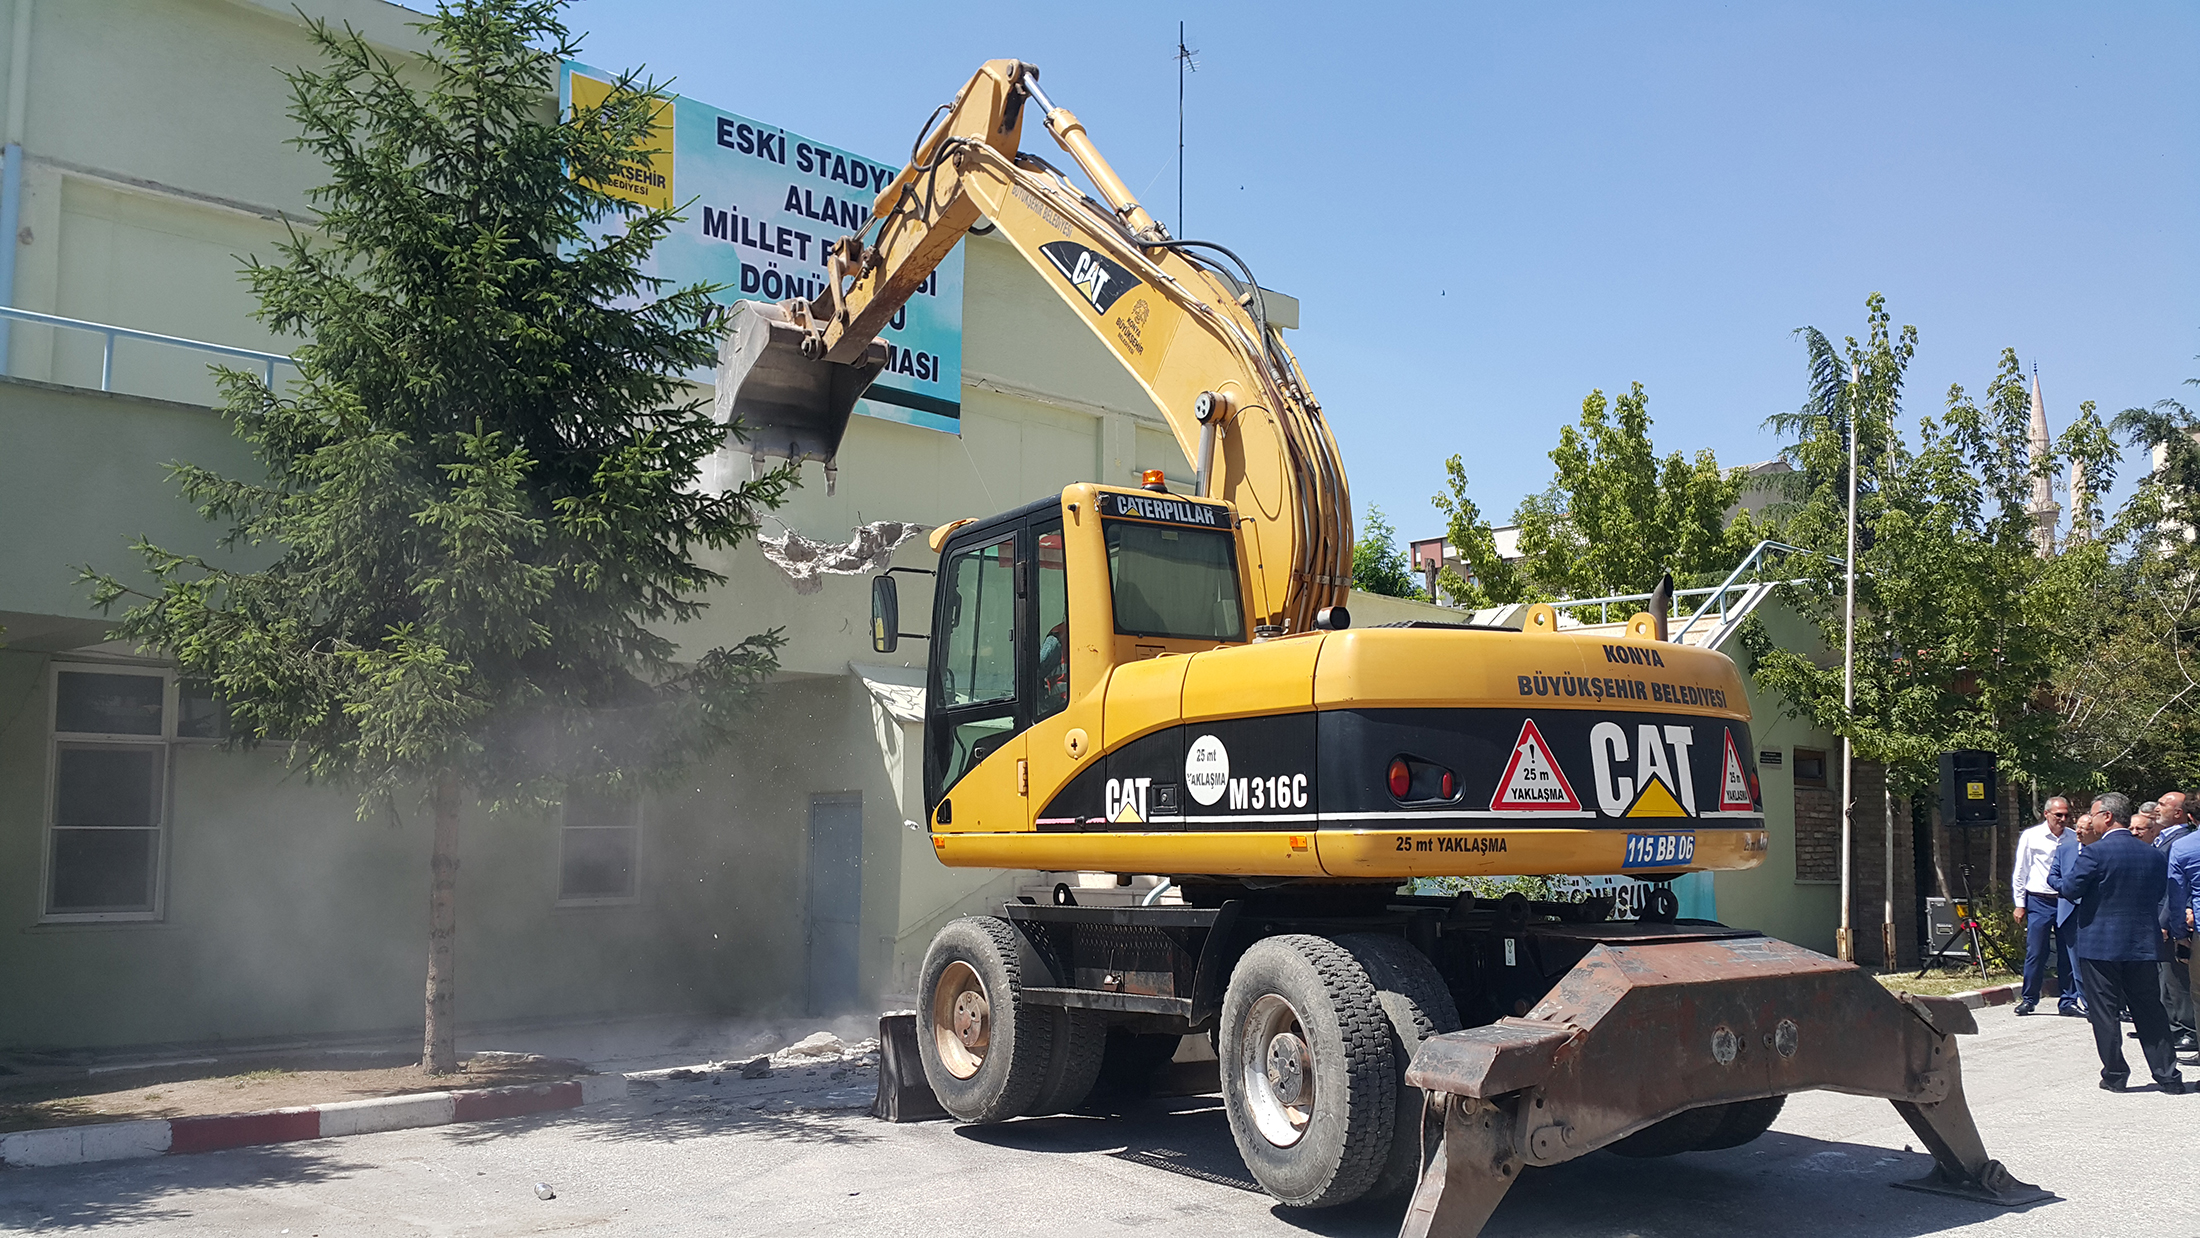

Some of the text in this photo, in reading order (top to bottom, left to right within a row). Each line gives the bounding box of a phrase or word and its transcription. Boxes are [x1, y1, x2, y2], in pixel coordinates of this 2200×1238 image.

[716, 116, 786, 166] ESKİ
[702, 205, 812, 262] MİLLET
[1072, 250, 1111, 305] CAT
[1116, 495, 1216, 525] CATERPILLAR
[1602, 644, 1666, 669] KONYA
[1517, 670, 1728, 709] BÜYÜKŞEHİR BELEDİYESİ
[1196, 748, 1217, 763] 25 mt
[1590, 721, 1697, 819] CAT
[1523, 767, 1550, 781] 25 m
[1105, 777, 1152, 823] CAT
[1510, 787, 1565, 803] YAKLAŞMA
[1395, 836, 1508, 857] 25 mt YAKLAŞMA
[1628, 834, 1695, 863] 115 BB 06
